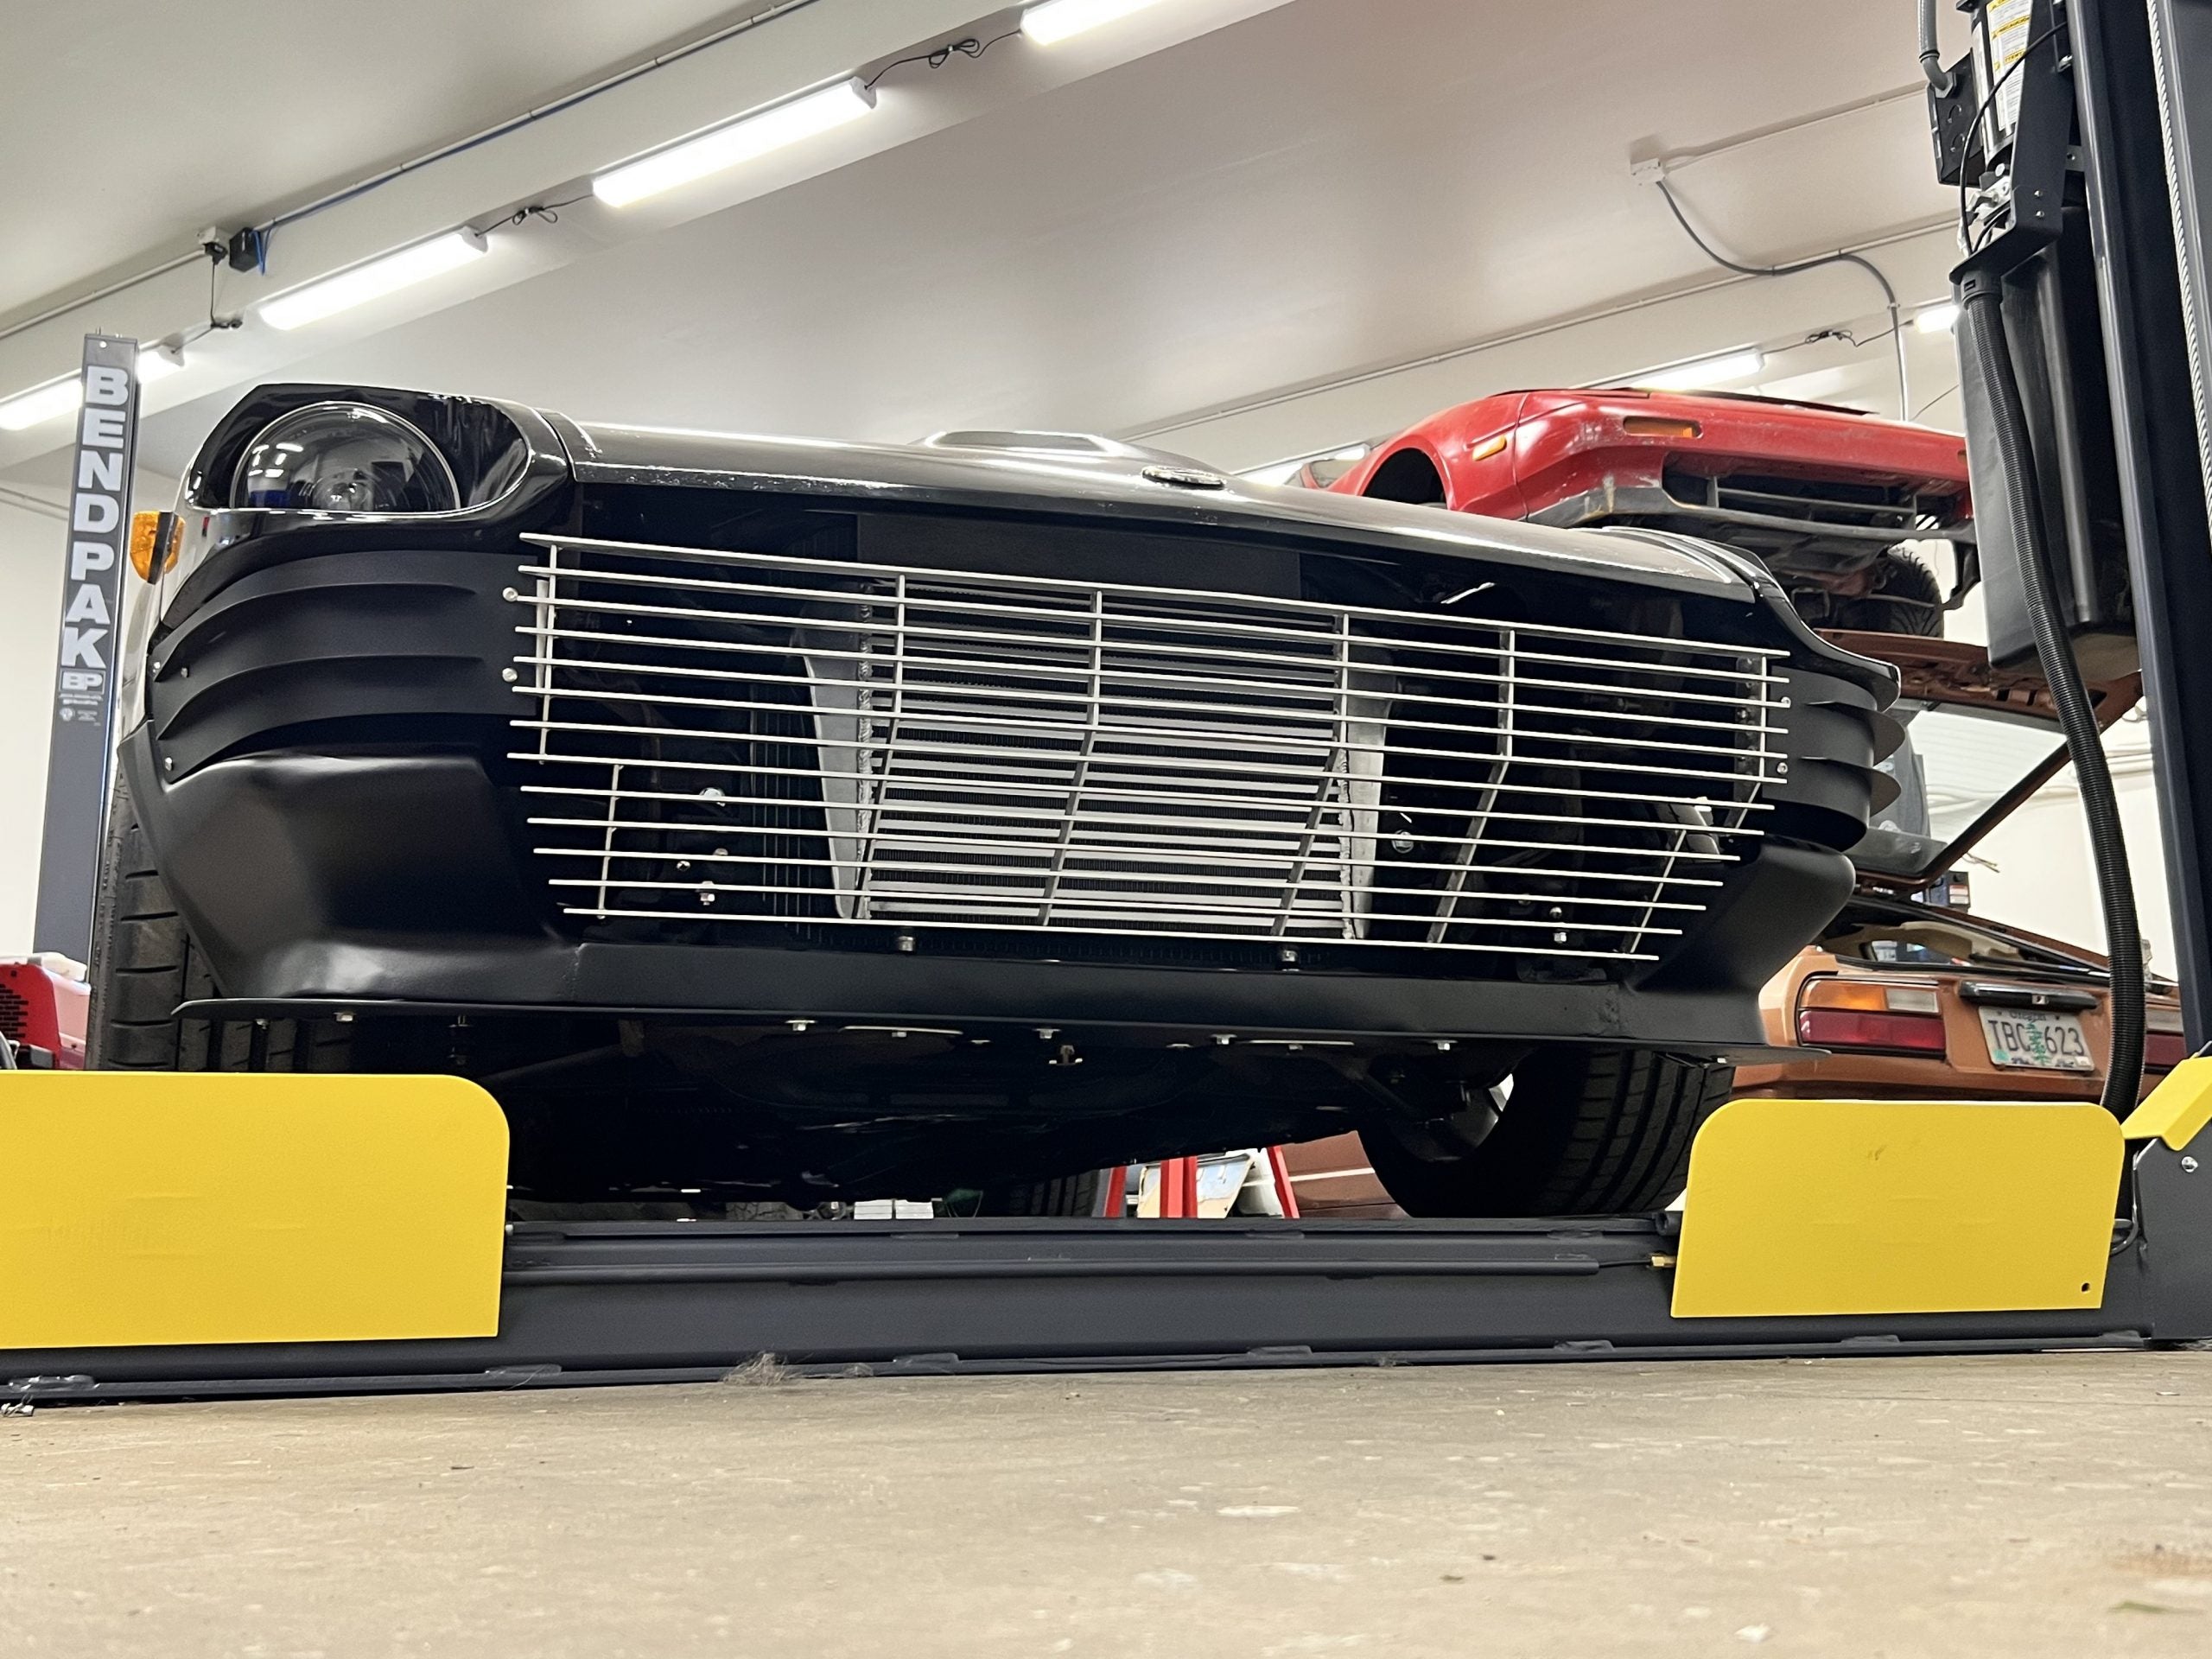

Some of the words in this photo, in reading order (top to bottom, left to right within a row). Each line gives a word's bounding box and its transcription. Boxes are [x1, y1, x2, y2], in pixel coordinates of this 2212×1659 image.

[60, 365, 129, 669] BENDPAK
[61, 672, 103, 690] BP
[1988, 1020, 2031, 1052] TBC
[2044, 1026, 2084, 1056] 623
